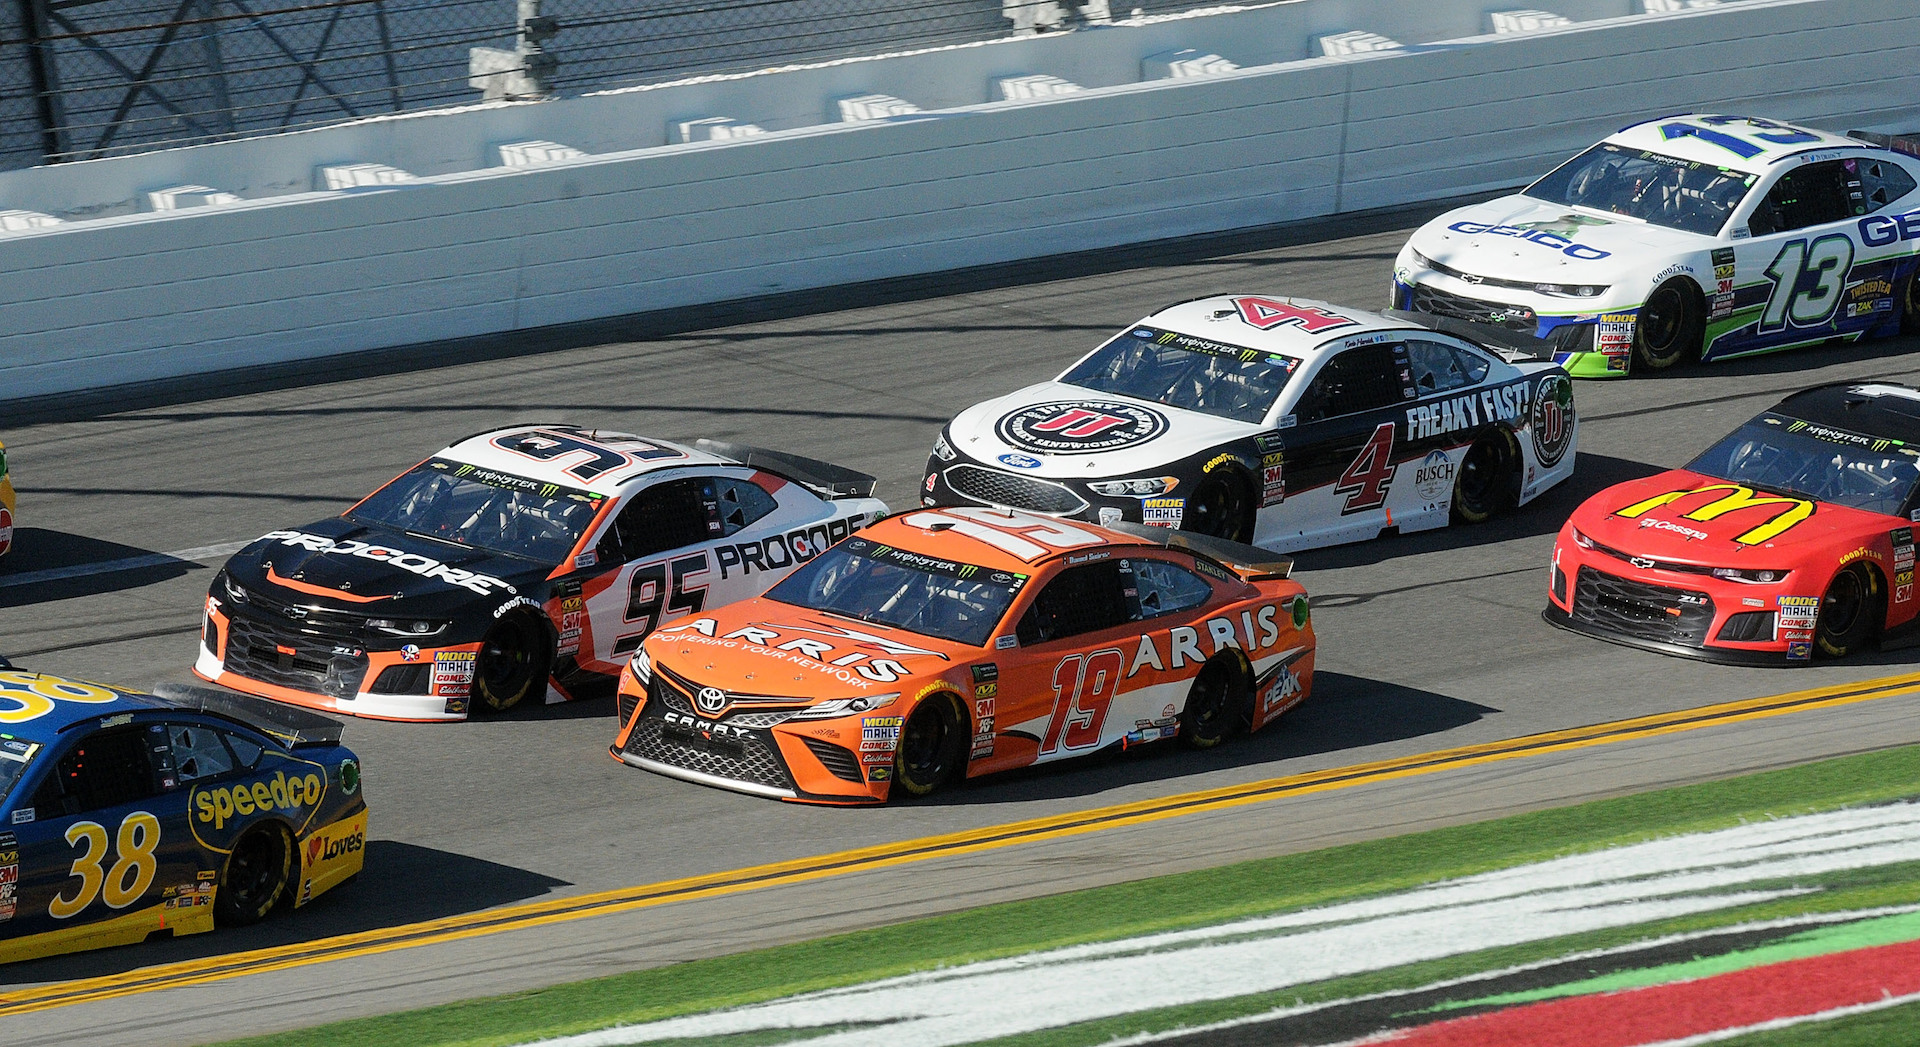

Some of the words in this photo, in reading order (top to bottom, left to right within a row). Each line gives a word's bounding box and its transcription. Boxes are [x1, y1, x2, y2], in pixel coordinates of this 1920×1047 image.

[1657, 115, 1825, 161] 13
[1447, 221, 1612, 260] GEICO
[1717, 280, 1733, 294] 3M
[1757, 232, 1854, 335] 13
[1230, 295, 1363, 336] 4
[1600, 314, 1637, 323] MOOG
[1601, 323, 1636, 332] MAHLE
[1036, 401, 1121, 416] JIMMY
[1406, 394, 1480, 443] FREAKY
[1481, 380, 1530, 424] FAST!
[1003, 454, 1039, 470] Ford
[1334, 421, 1396, 517] 4
[1265, 467, 1282, 484] 3M
[1415, 463, 1454, 484] BUSCH
[1143, 499, 1184, 508] MOOG
[1144, 509, 1182, 518] MAHLE
[1655, 521, 1708, 541] Cessna
[1195, 561, 1228, 580] STANLEY
[206, 596, 223, 616] 95
[493, 595, 542, 619] GOODYEAR
[610, 548, 711, 661] 95
[1677, 595, 1708, 606] ZL1
[1777, 597, 1818, 605] MOOG
[1782, 606, 1819, 616] MAHLE
[331, 645, 362, 658] ZL1
[656, 617, 914, 684] ARRIS
[1126, 604, 1280, 681] ARRIS
[435, 652, 477, 661] MOOG
[648, 631, 737, 650] POWERING
[740, 643, 787, 661] YOUR
[787, 655, 874, 691] NETWORK
[437, 662, 475, 672] MAHLE
[1038, 646, 1126, 758] 19
[1263, 670, 1302, 714] PEAK
[977, 699, 995, 718] 3M
[663, 711, 751, 738] CAMRY
[864, 717, 904, 727] MOOG
[863, 728, 899, 740] MAHLE
[195, 770, 321, 831] speedco
[48, 810, 162, 920] 38
